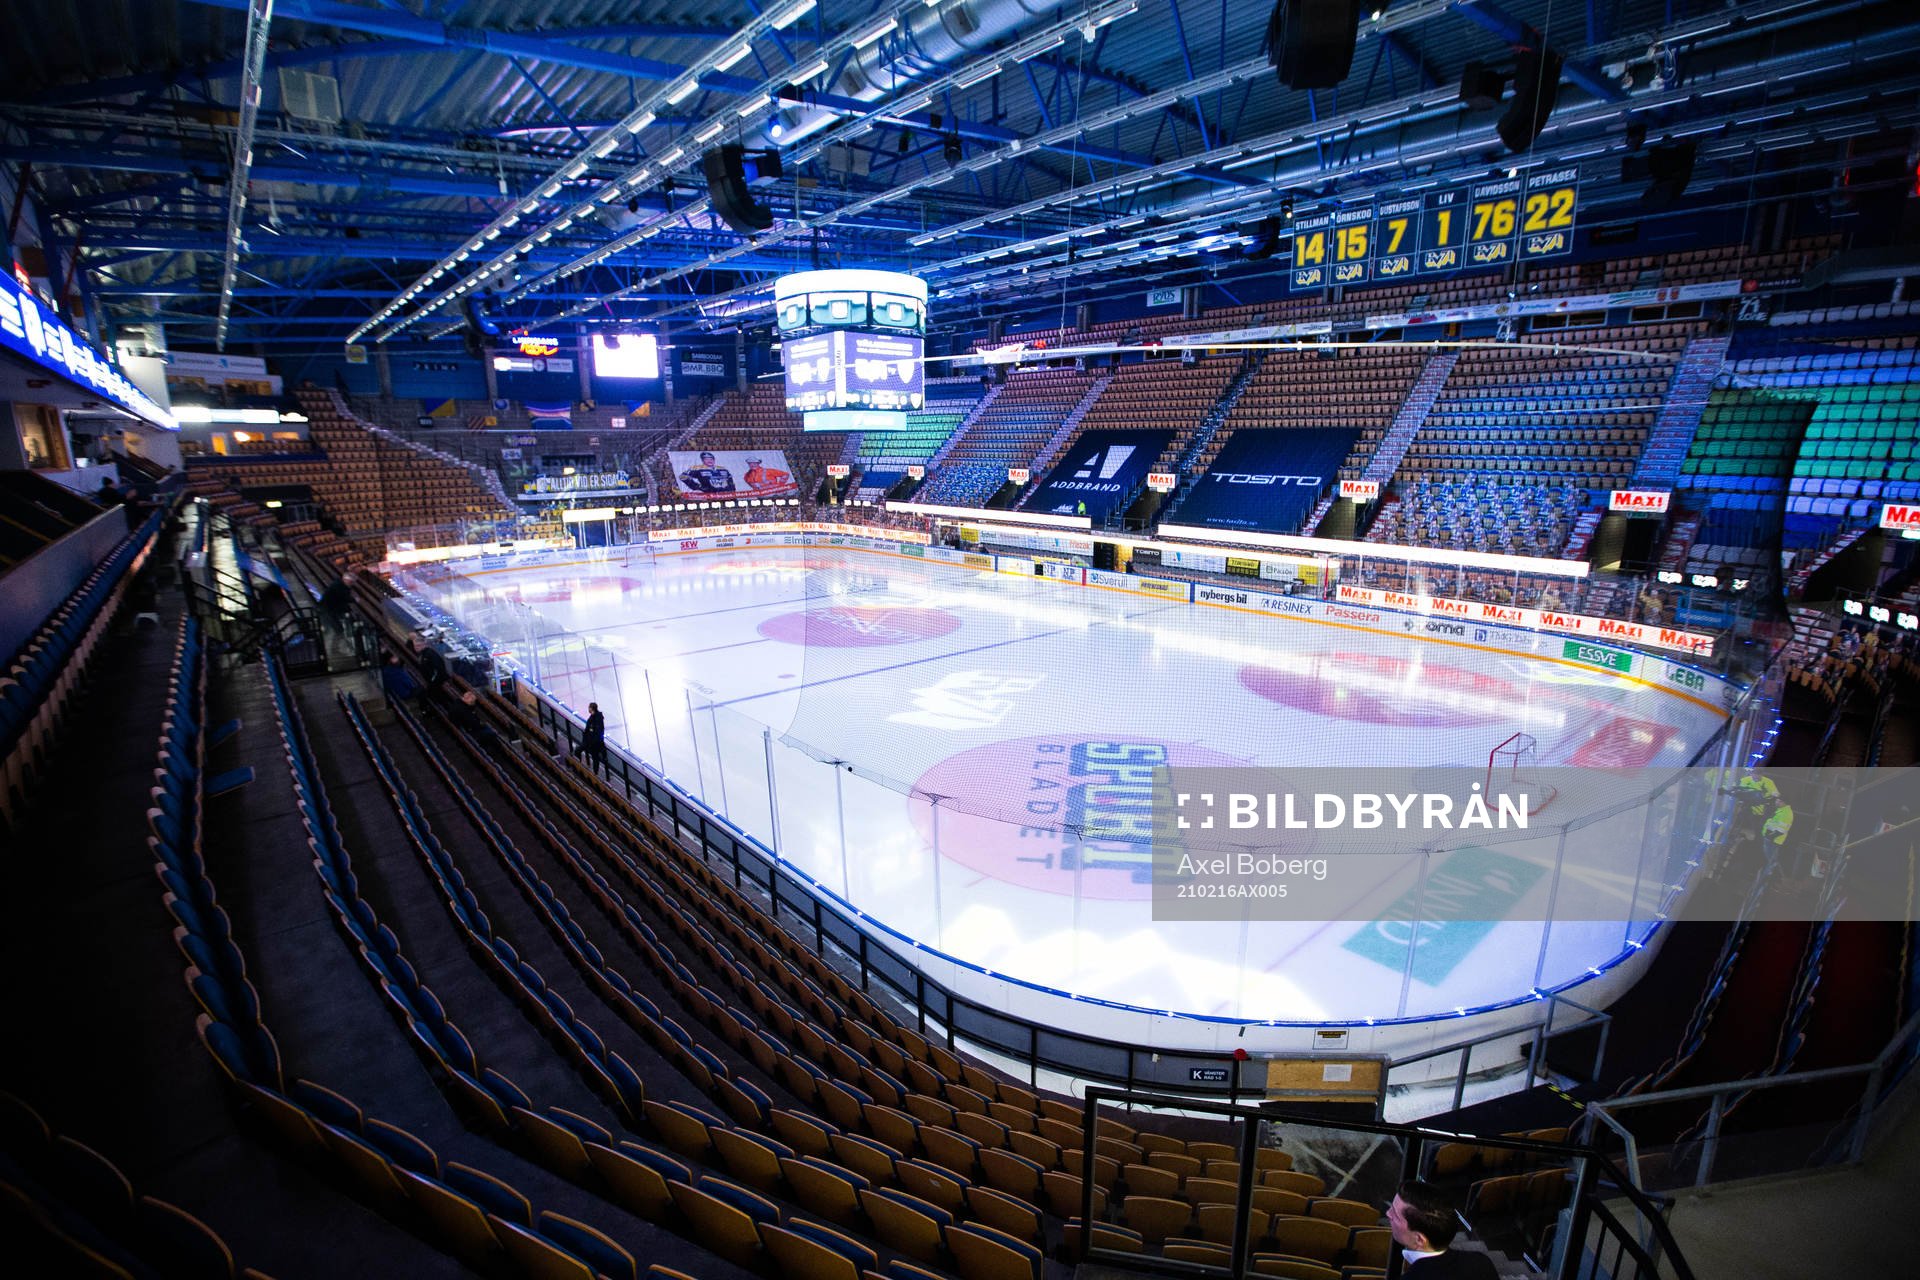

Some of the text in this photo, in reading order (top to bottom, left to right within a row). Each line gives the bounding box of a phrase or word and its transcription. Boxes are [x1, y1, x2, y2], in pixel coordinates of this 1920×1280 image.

[1529, 168, 1577, 187] PETRASEK
[1475, 180, 1520, 198] DAVIDSSON
[1438, 193, 1454, 205] LIV
[1380, 200, 1420, 216] GUSTAFSSON
[1524, 188, 1575, 233] 22
[1296, 216, 1329, 231] STILLMAN
[1438, 210, 1451, 246] 1
[1472, 199, 1517, 241] 76
[1337, 225, 1367, 261] 15
[1387, 218, 1408, 254] 7
[1296, 232, 1325, 267] 14
[1050, 480, 1121, 492] ADDBRAND
[1150, 475, 1173, 485] MAXI
[1212, 472, 1322, 486] TOSITO
[1343, 482, 1375, 494] MAXI
[1614, 493, 1662, 507] MAXI
[1887, 506, 1920, 523] MA
[784, 536, 811, 544] Elmia
[1200, 589, 1247, 604] nybergs bil
[1341, 586, 1372, 600] MAXI
[1385, 592, 1418, 606] MAXI
[1271, 600, 1313, 615] RESINEX
[1326, 604, 1380, 622] Passera
[1432, 598, 1468, 614] MAXI
[1483, 605, 1522, 623] MAXI
[1540, 613, 1581, 628] MAXI
[1599, 620, 1643, 638] MAXI
[1660, 629, 1706, 650] MAXI
[1578, 646, 1617, 666] ESSVE
[1015, 742, 1067, 870] BLADET
[1193, 1070, 1202, 1080] K
